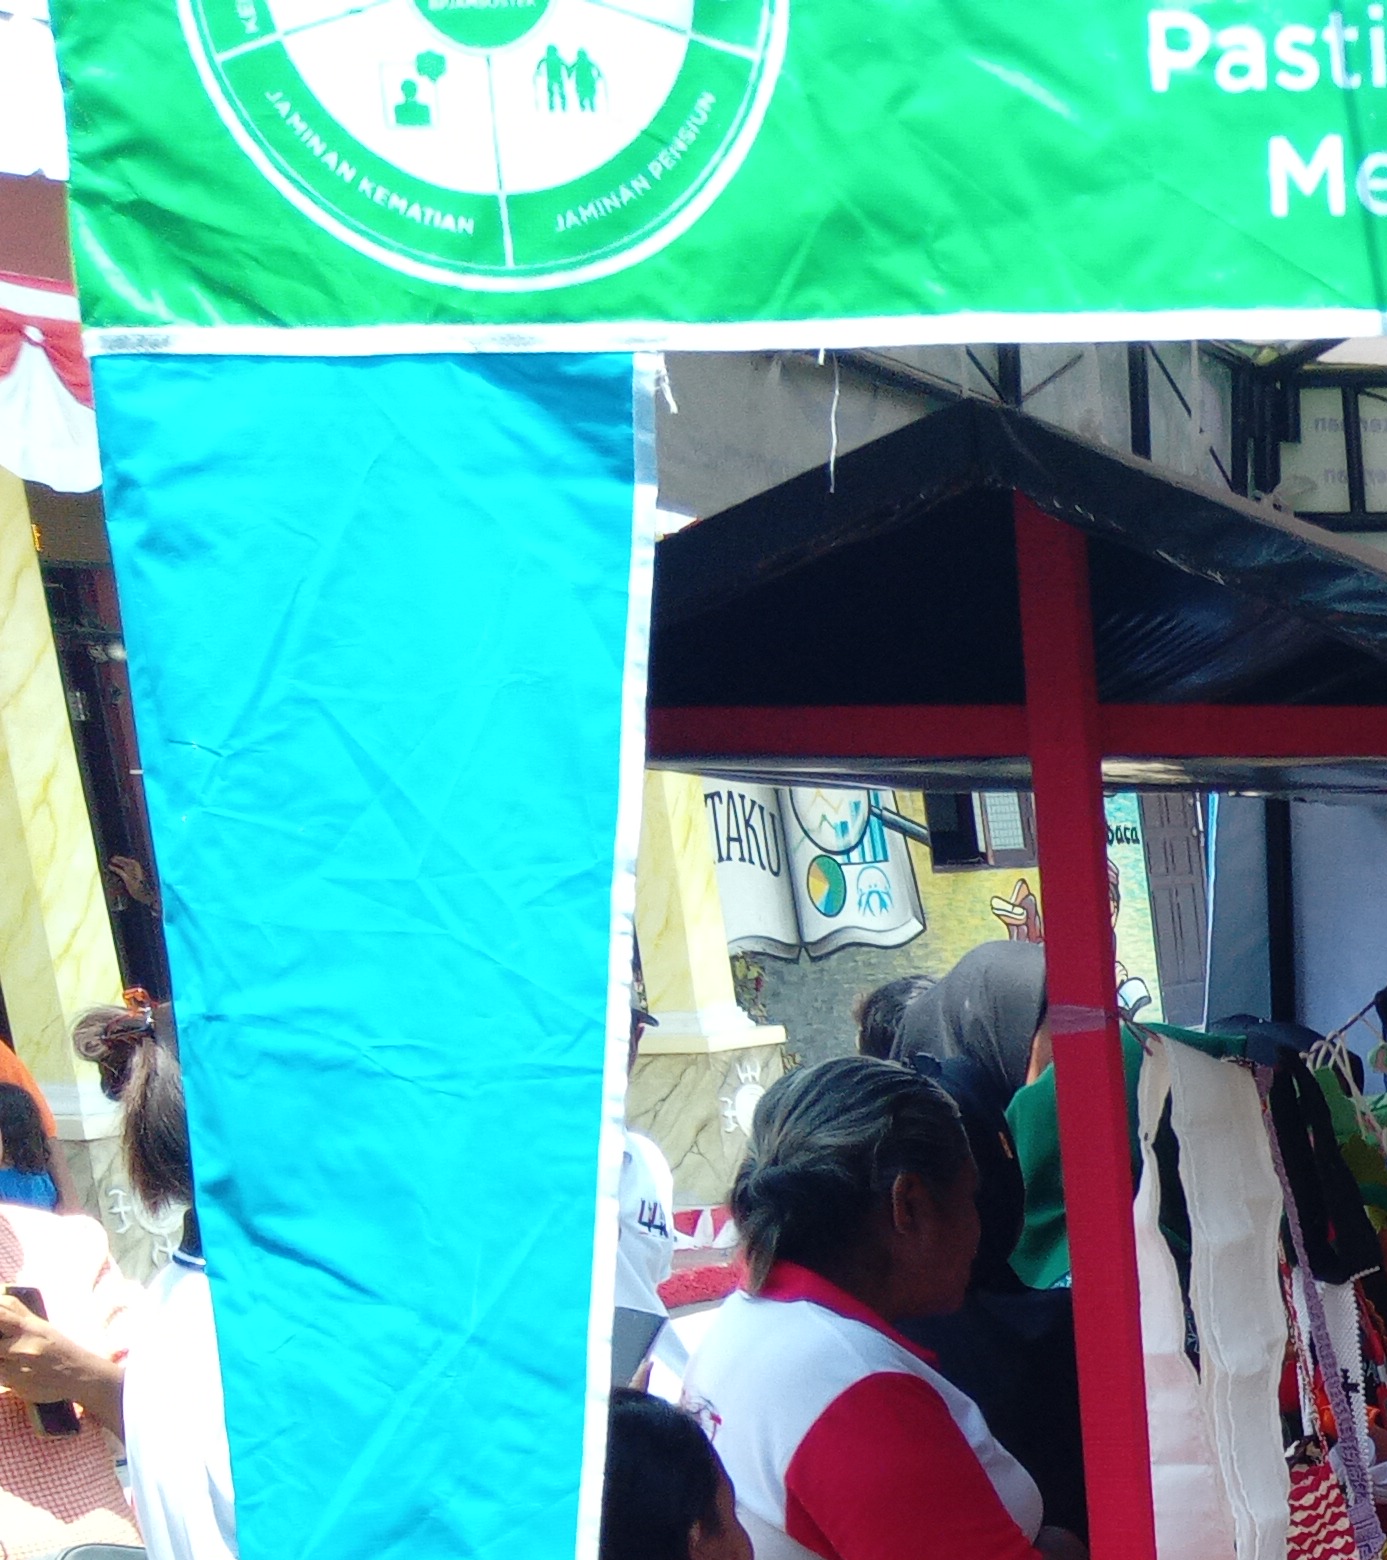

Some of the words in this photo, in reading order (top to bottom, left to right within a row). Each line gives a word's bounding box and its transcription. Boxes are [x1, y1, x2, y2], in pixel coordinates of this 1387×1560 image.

[264, 89, 357, 183] JAMINAN
[357, 174, 475, 236] KEMATIAN
[555, 172, 652, 233] JAMINAN
[646, 90, 718, 181] PENSIUN
[703, 790, 781, 878] TAKU
